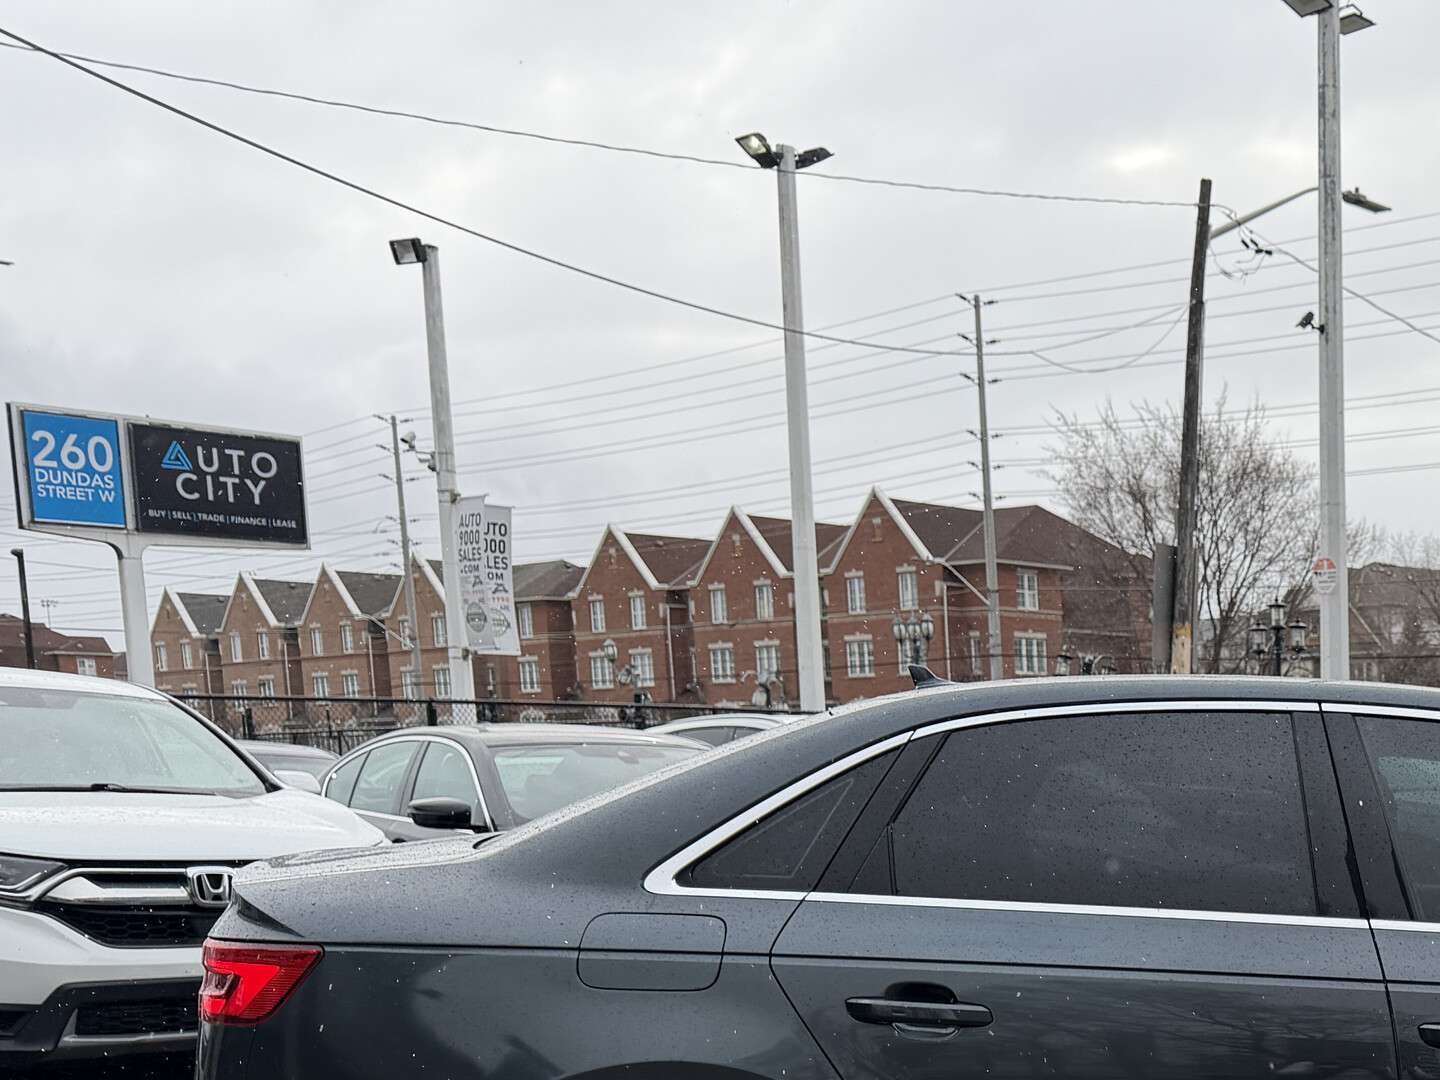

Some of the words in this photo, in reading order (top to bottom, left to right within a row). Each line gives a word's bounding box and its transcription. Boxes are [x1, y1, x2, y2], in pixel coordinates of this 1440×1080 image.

[31, 430, 113, 473] 260
[35, 468, 115, 489] DUNDAS
[37, 485, 96, 501] STREET
[98, 489, 116, 503] W
[175, 472, 266, 506] CITY
[148, 508, 167, 518] BUY
[171, 510, 193, 522] SELL
[198, 512, 225, 523] TRADE
[230, 514, 267, 527] FINANCE
[272, 517, 297, 529] LEASE
[458, 512, 482, 528] AUTO
[458, 529, 480, 547] 9000
[458, 548, 482, 563] SALES
[484, 555, 509, 571] LES
